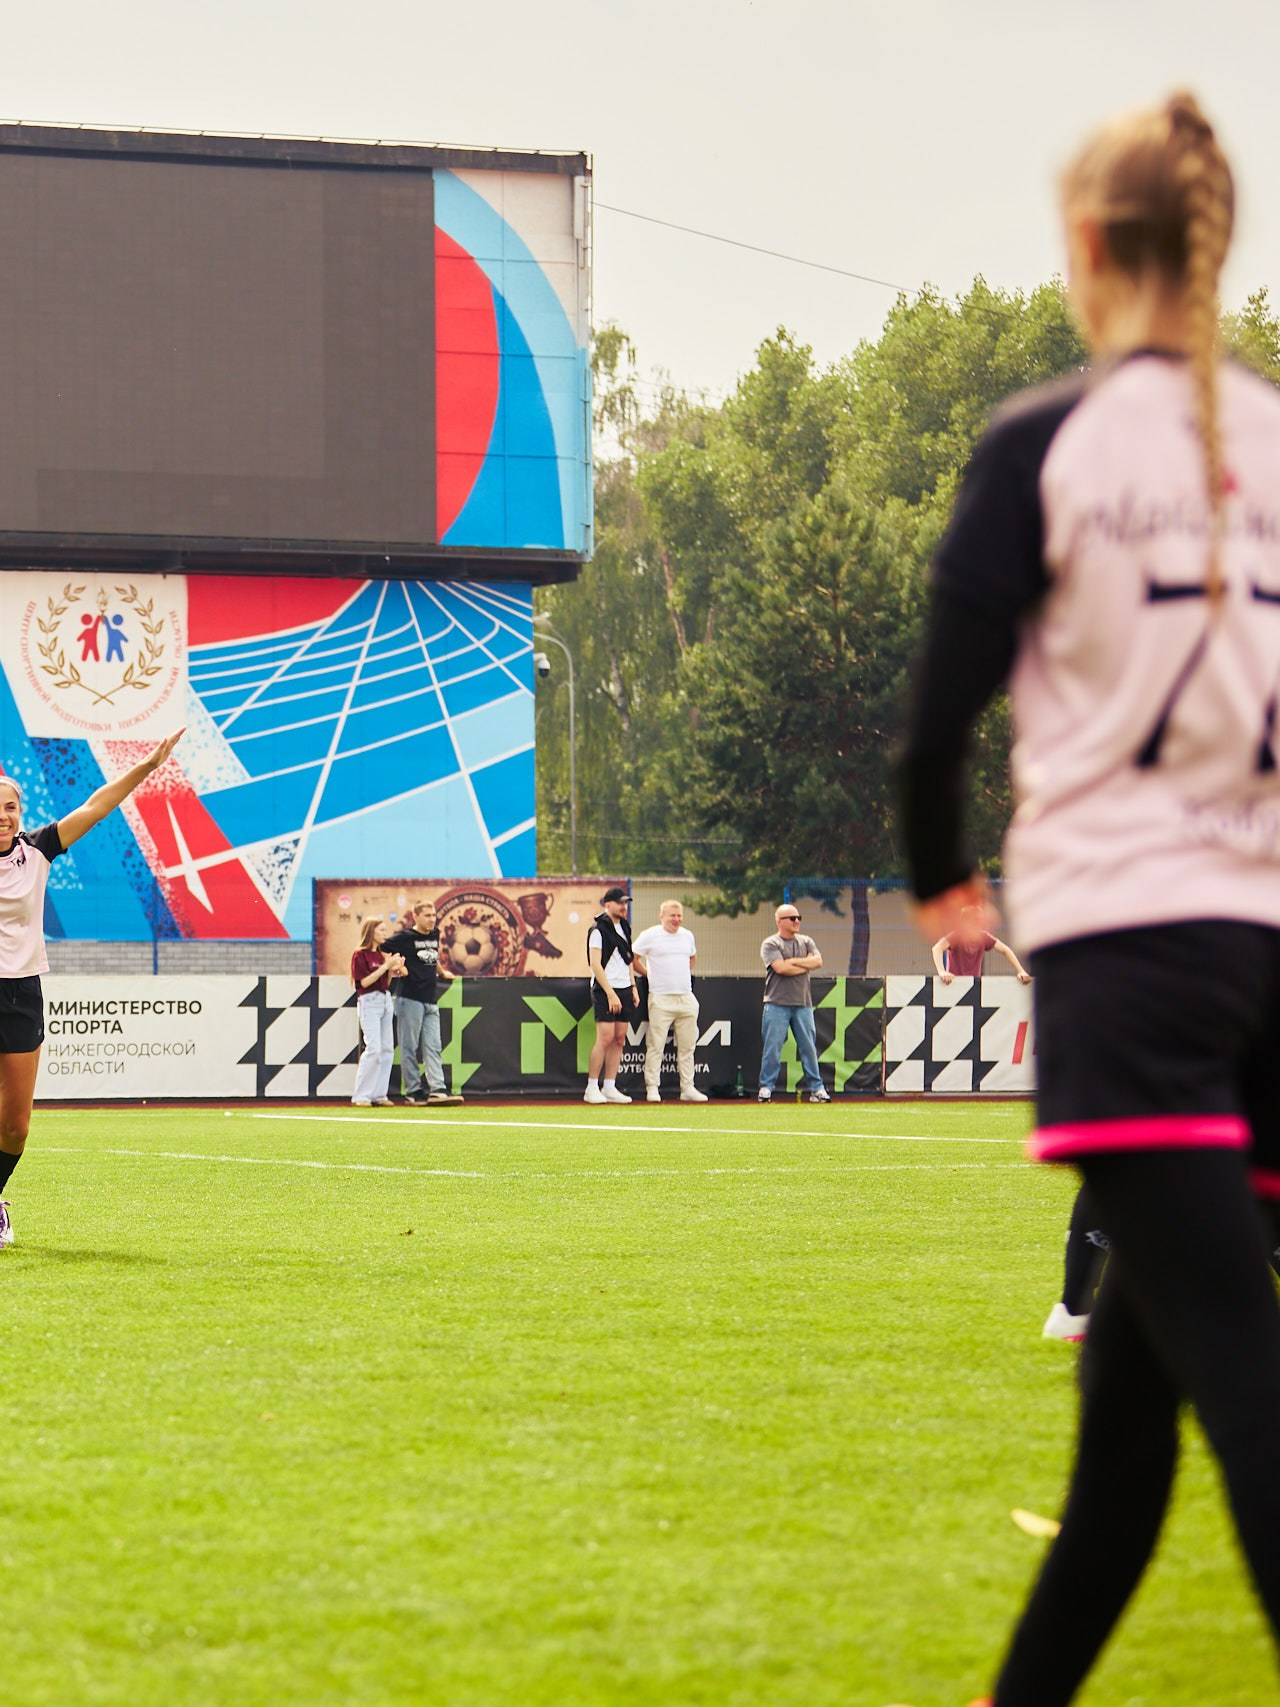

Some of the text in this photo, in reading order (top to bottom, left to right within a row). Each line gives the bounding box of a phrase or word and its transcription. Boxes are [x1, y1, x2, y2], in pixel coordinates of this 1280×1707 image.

[50, 703, 112, 732] ПОДГОТОВКИ
[48, 1000, 202, 1016] МИНИСТЕРСТВО
[48, 1020, 123, 1035] СПОРТА
[47, 1040, 196, 1058] НИЖЕГОРОДСКОЙ
[47, 1062, 125, 1075] ОБЛАСТИ
